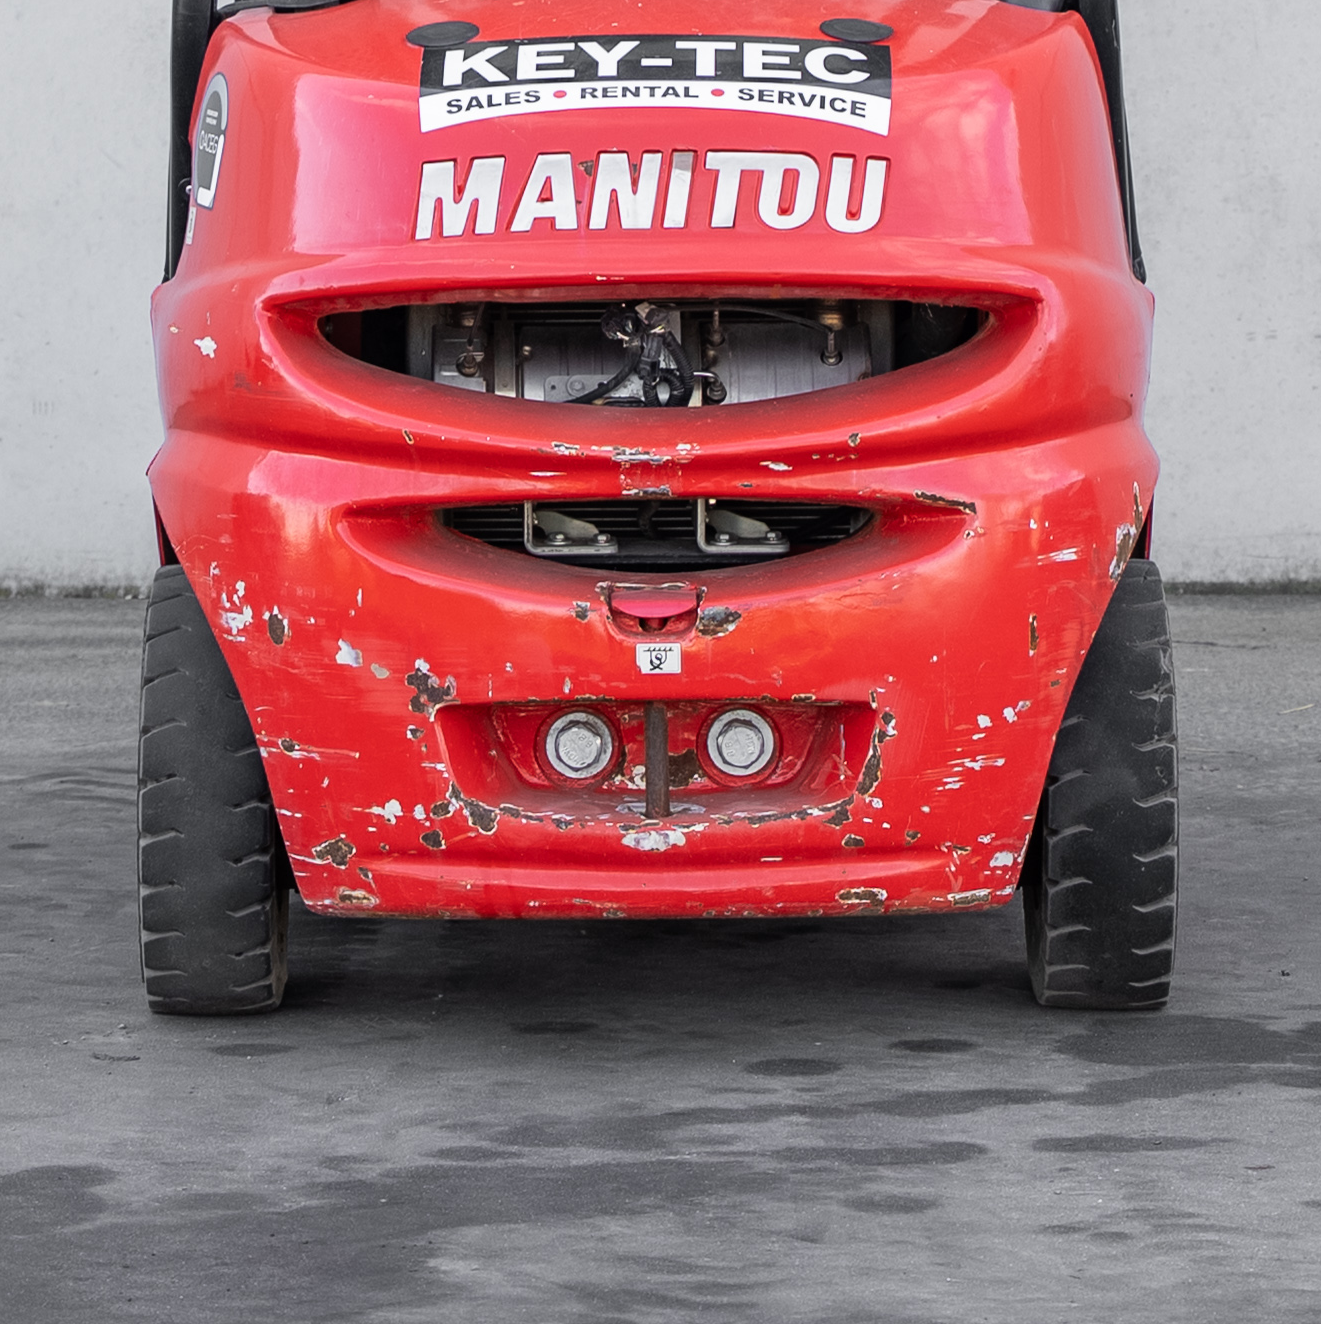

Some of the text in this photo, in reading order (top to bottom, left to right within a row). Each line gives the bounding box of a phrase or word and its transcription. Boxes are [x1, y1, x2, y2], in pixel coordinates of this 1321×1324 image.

[442, 40, 872, 87] KEY-TEC
[446, 84, 868, 119] SALES RENTAL SERVICE
[414, 150, 888, 241] MANITOU
